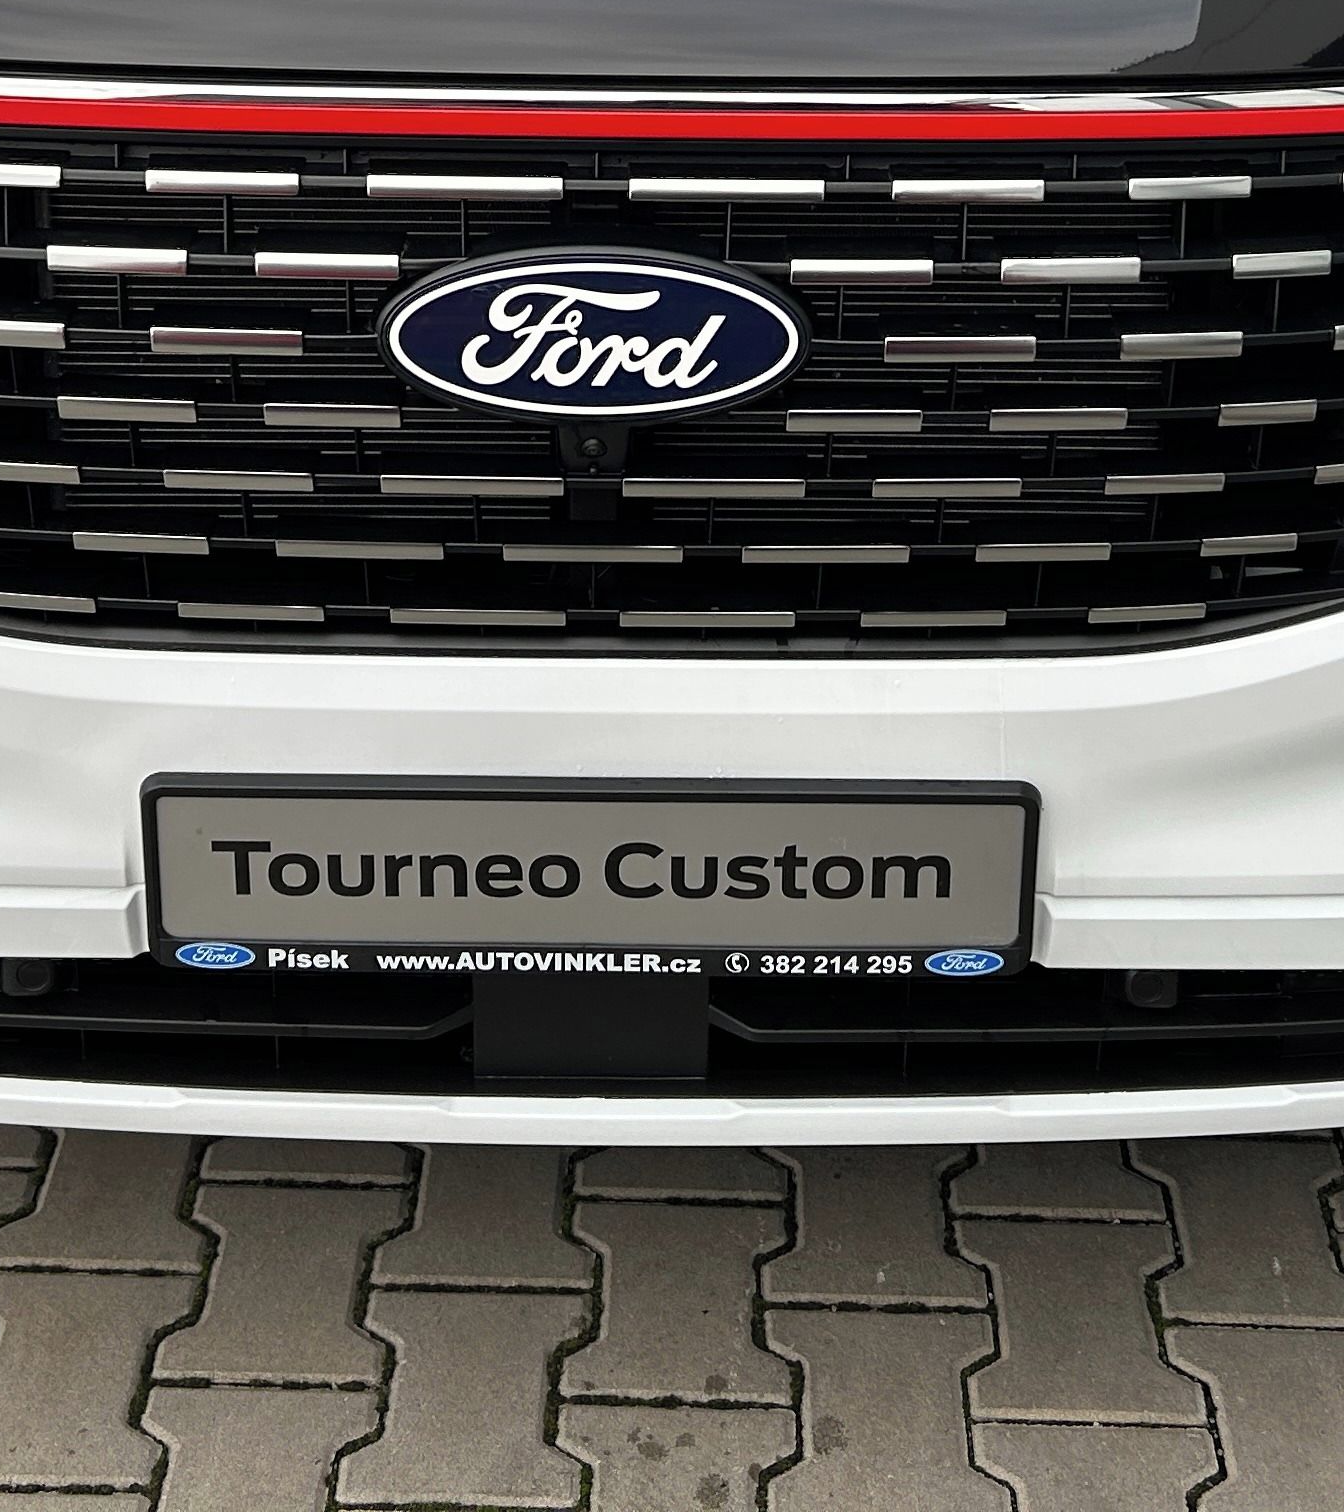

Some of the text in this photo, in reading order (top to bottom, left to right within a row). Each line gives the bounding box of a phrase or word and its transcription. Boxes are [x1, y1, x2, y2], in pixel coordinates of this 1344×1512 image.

[461, 283, 726, 389] Ford
[211, 840, 951, 900] Tourneo Custom
[268, 947, 350, 970] Písek
[376, 951, 702, 975] www.AUTOVINKLER.cz
[760, 955, 805, 975] 382
[813, 955, 859, 975] 214
[867, 955, 913, 975] 295
